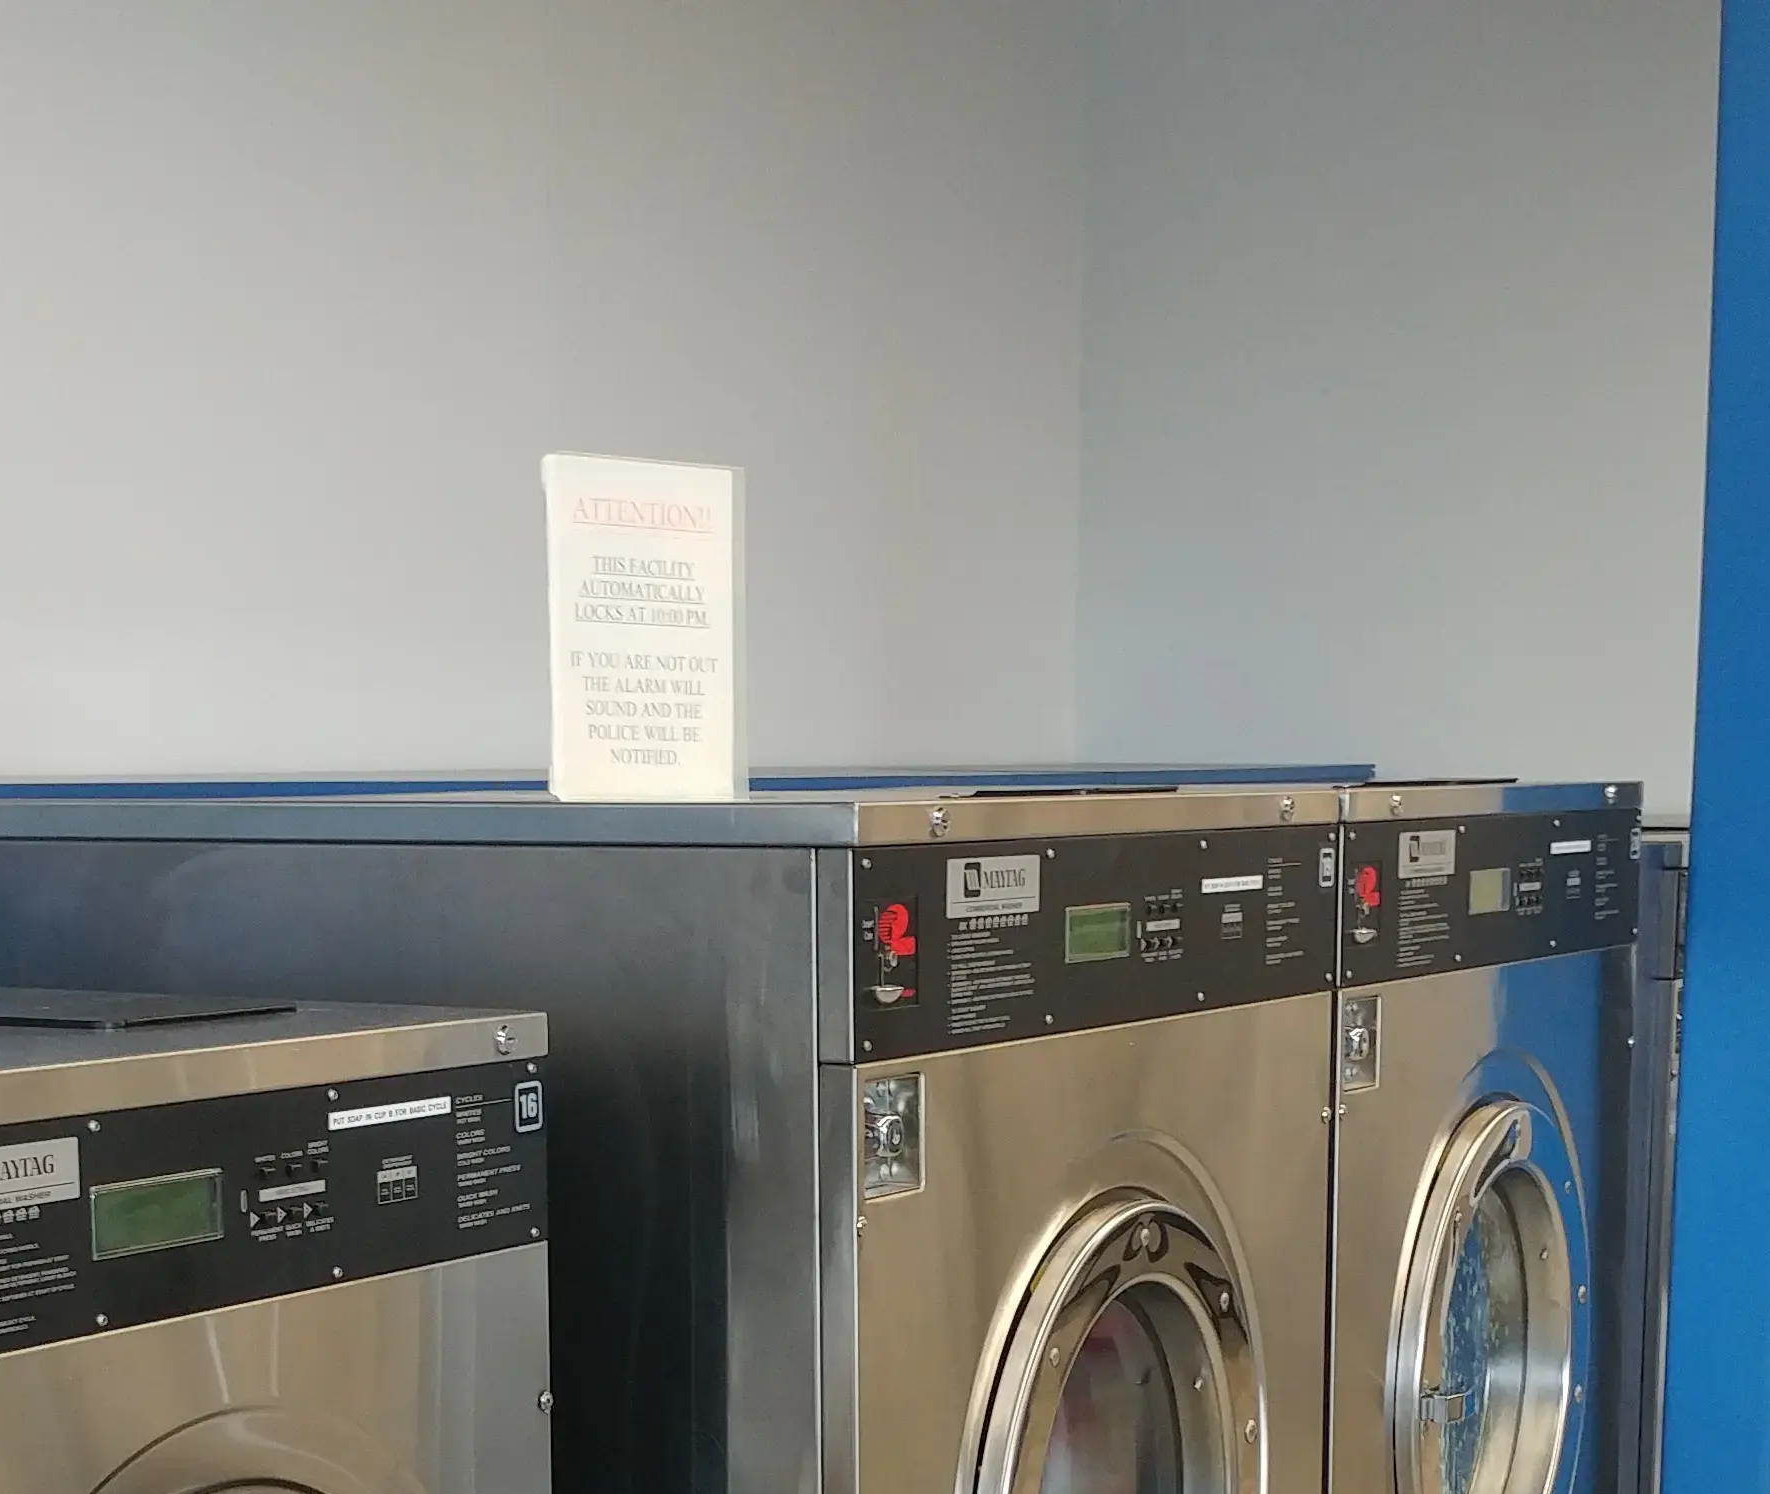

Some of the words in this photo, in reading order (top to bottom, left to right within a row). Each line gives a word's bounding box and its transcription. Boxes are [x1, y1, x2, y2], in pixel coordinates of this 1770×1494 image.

[591, 555, 625, 573] THIS
[629, 558, 695, 578] FACILITY
[579, 580, 705, 602] AUTOMATICALLY
[575, 602, 624, 621] LOCKS
[628, 607, 646, 622] AT
[571, 651, 583, 667] IF
[588, 652, 619, 668] YOU
[625, 654, 651, 670] ARE
[656, 656, 686, 672] NOT
[689, 657, 718, 673] OUT
[582, 676, 610, 692] THE
[615, 678, 666, 694] ALARM
[670, 680, 705, 696] WILL
[586, 700, 637, 717] SOUND
[641, 702, 672, 718] AND
[675, 703, 702, 719] THE
[588, 724, 639, 740] POLICE
[644, 726, 679, 742] WILL
[683, 727, 702, 742] BE
[610, 749, 681, 765] NOTIFIED.
[333, 1117, 345, 1125] PUT
[347, 1114, 363, 1123] SOAP
[366, 1112, 372, 1120] IN
[374, 1111, 387, 1119] CUP
[395, 1106, 407, 1116] FOR
[409, 1104, 426, 1115] BASIC
[519, 1092, 538, 1119] 16
[15, 1191, 52, 1202] WASHER
